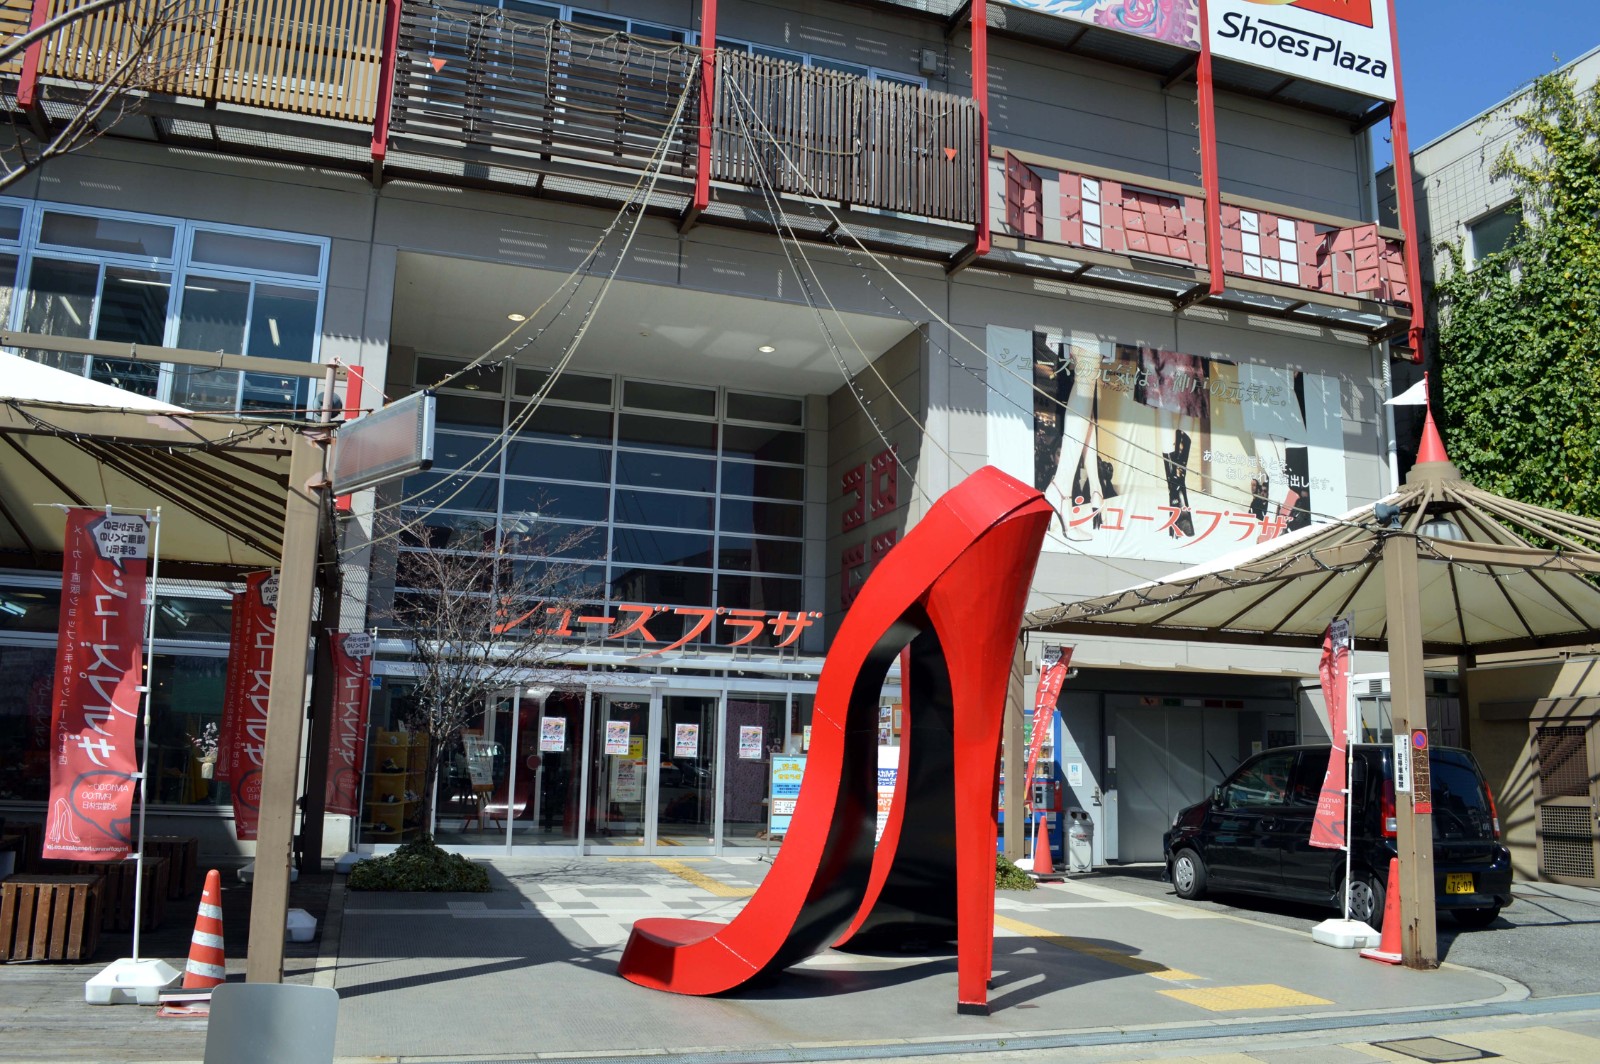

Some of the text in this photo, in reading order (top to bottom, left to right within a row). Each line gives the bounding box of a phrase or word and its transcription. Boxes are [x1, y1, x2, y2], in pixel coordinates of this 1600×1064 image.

[1069, 495, 1292, 549] シューズプラザ
[490, 597, 823, 661] シューズプラザ
